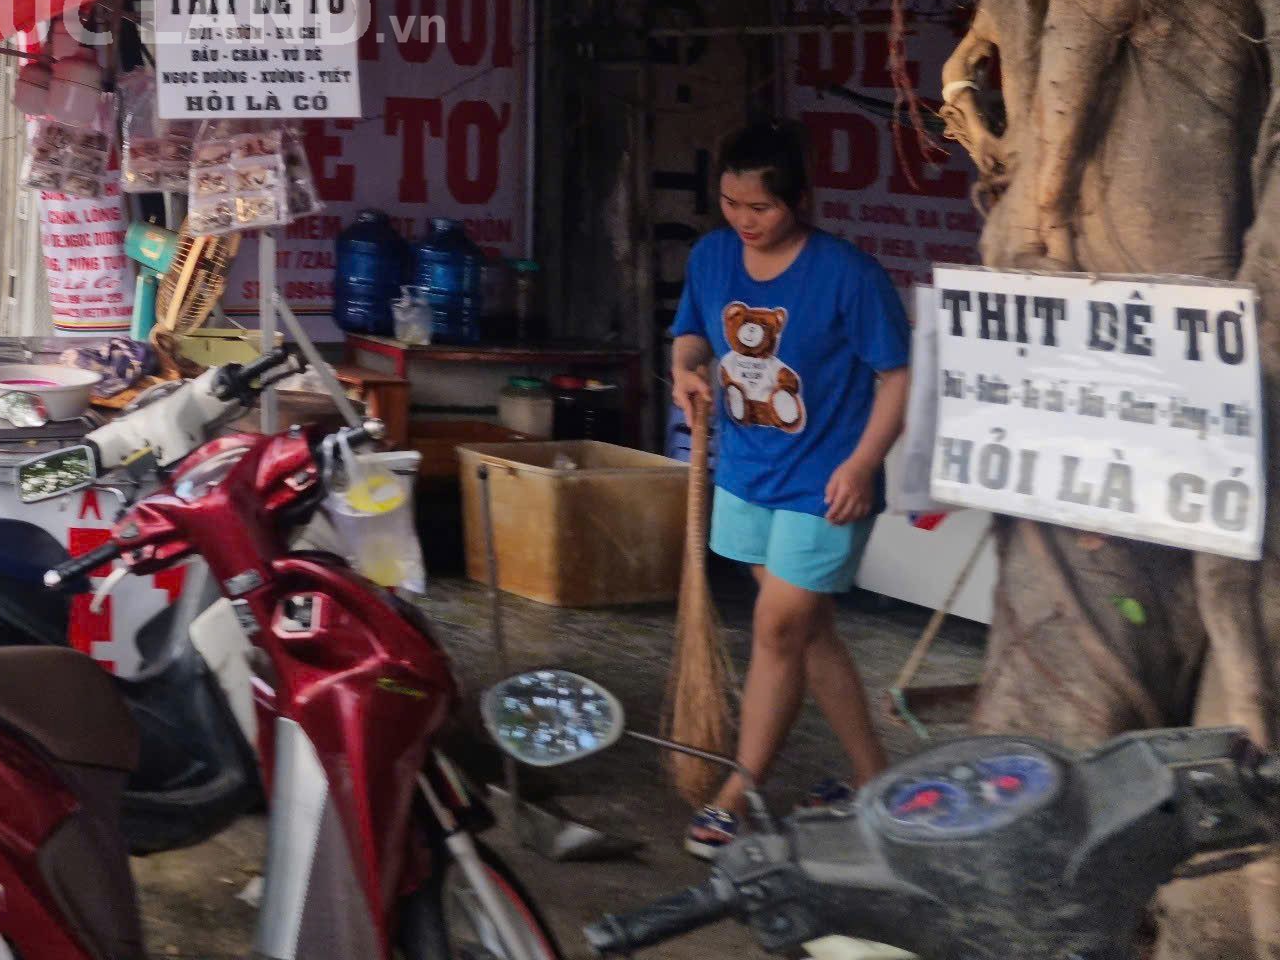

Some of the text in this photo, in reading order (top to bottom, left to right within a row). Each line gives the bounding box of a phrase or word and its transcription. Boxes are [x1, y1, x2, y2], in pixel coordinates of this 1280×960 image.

[245, 90, 282, 112] LÀ
[941, 288, 1070, 358] THỊT
[940, 426, 1251, 533] HỎI LÀ CÓ
